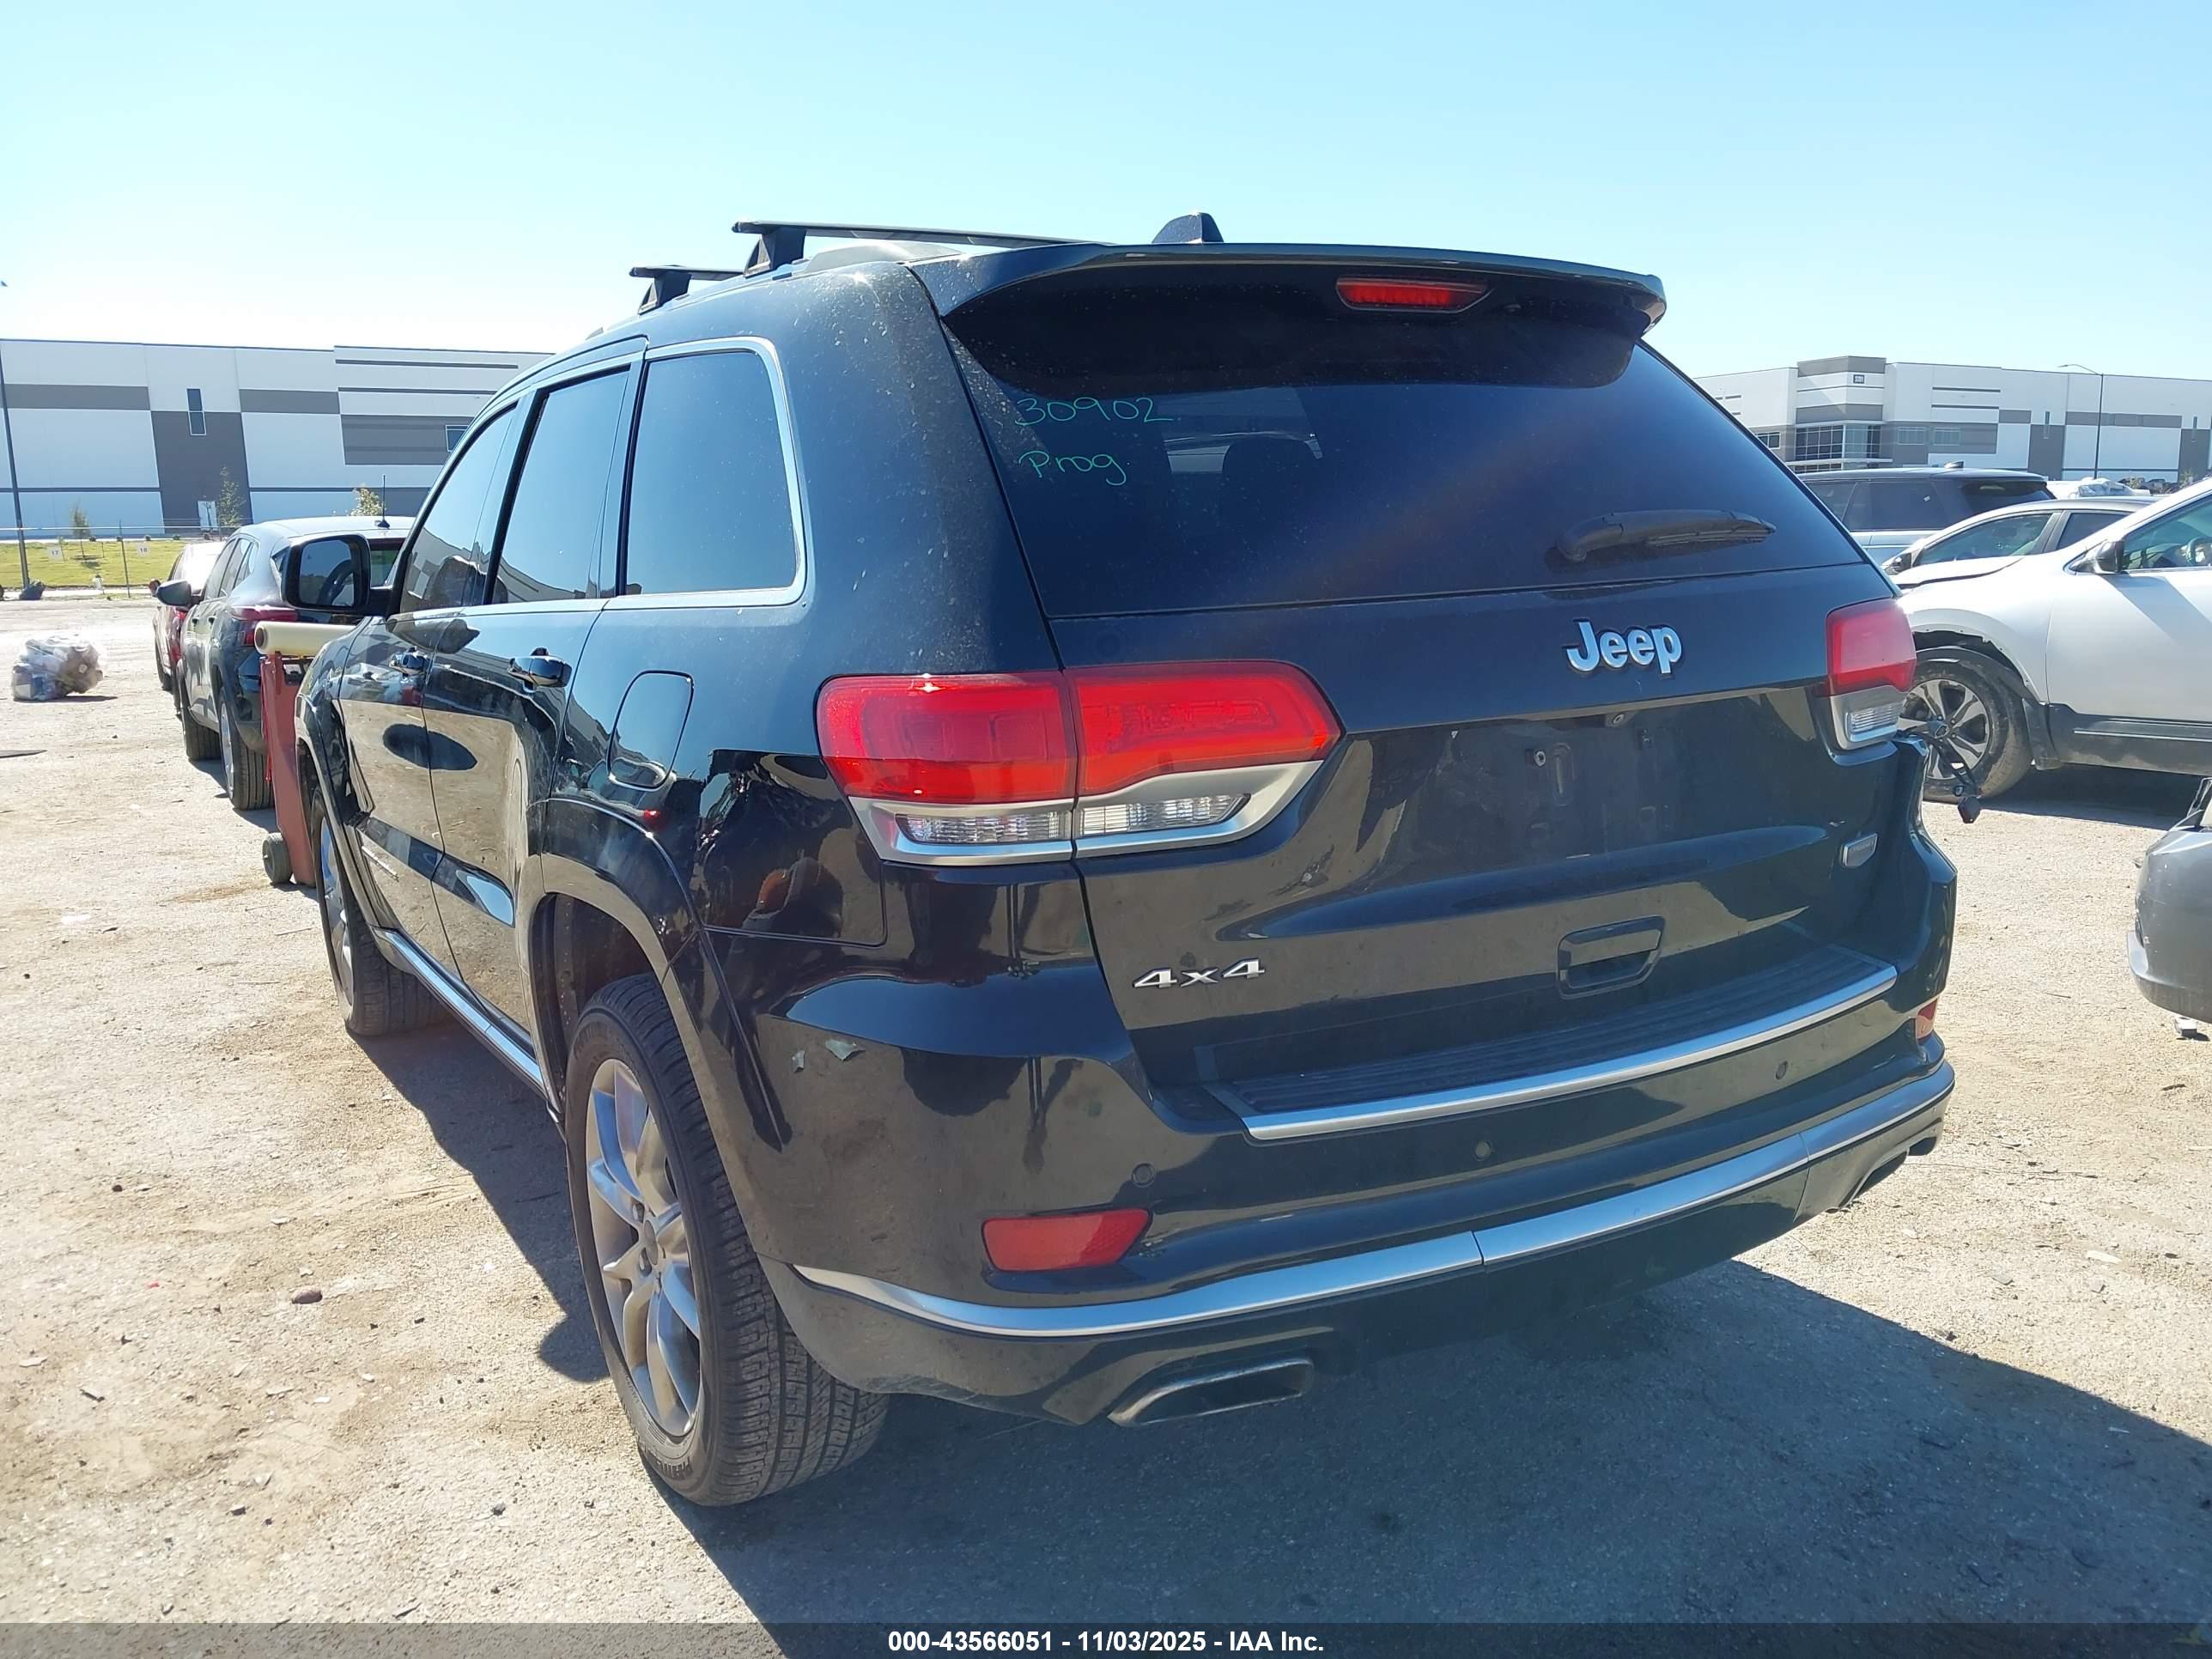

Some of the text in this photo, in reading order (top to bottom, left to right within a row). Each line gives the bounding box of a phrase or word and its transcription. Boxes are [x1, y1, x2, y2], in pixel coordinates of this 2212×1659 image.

[1015, 397, 1174, 427] 30902
[1018, 450, 1127, 486] Prog
[1565, 620, 1683, 675] Jeep
[1133, 957, 1266, 988] 4x4
